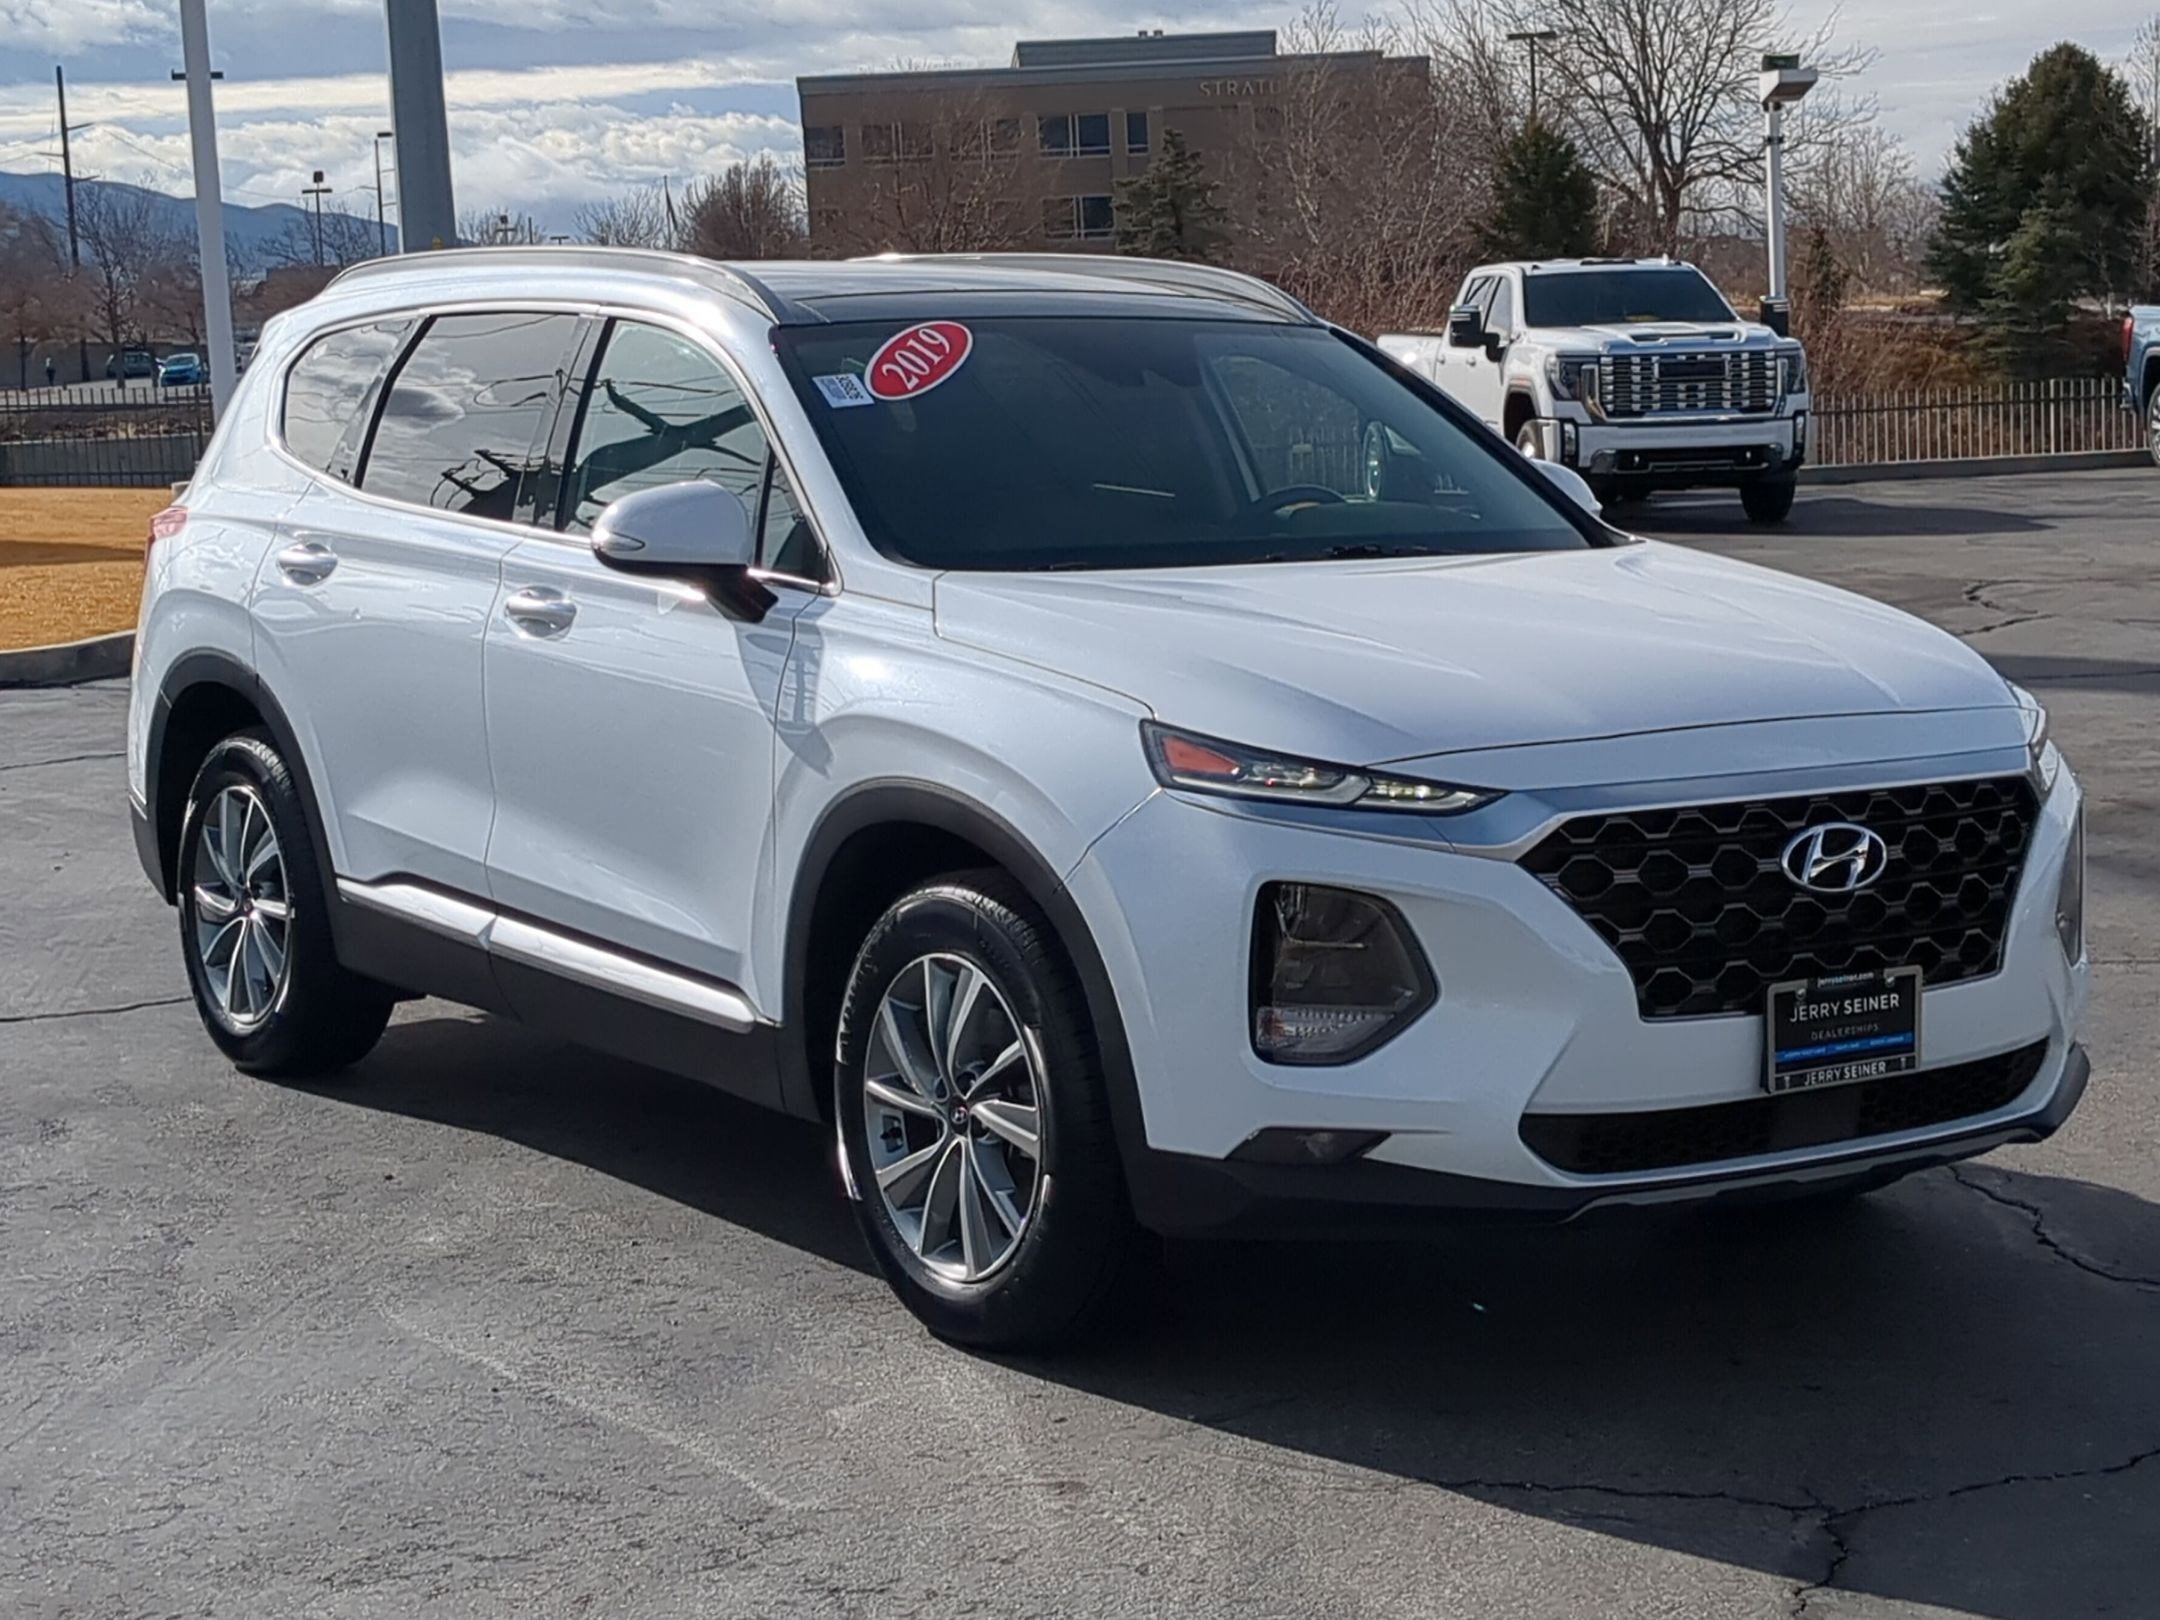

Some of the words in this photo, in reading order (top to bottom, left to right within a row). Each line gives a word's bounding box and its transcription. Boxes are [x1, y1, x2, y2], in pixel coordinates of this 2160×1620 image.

[882, 328, 950, 390] 2019
[1789, 1000, 1841, 1023] JERRY
[1843, 993, 1901, 1015] SEINER
[1810, 1023, 1880, 1042] DEALERSHIPS
[1804, 1068, 1842, 1086] JERRY
[1843, 1061, 1887, 1080] SEINER
